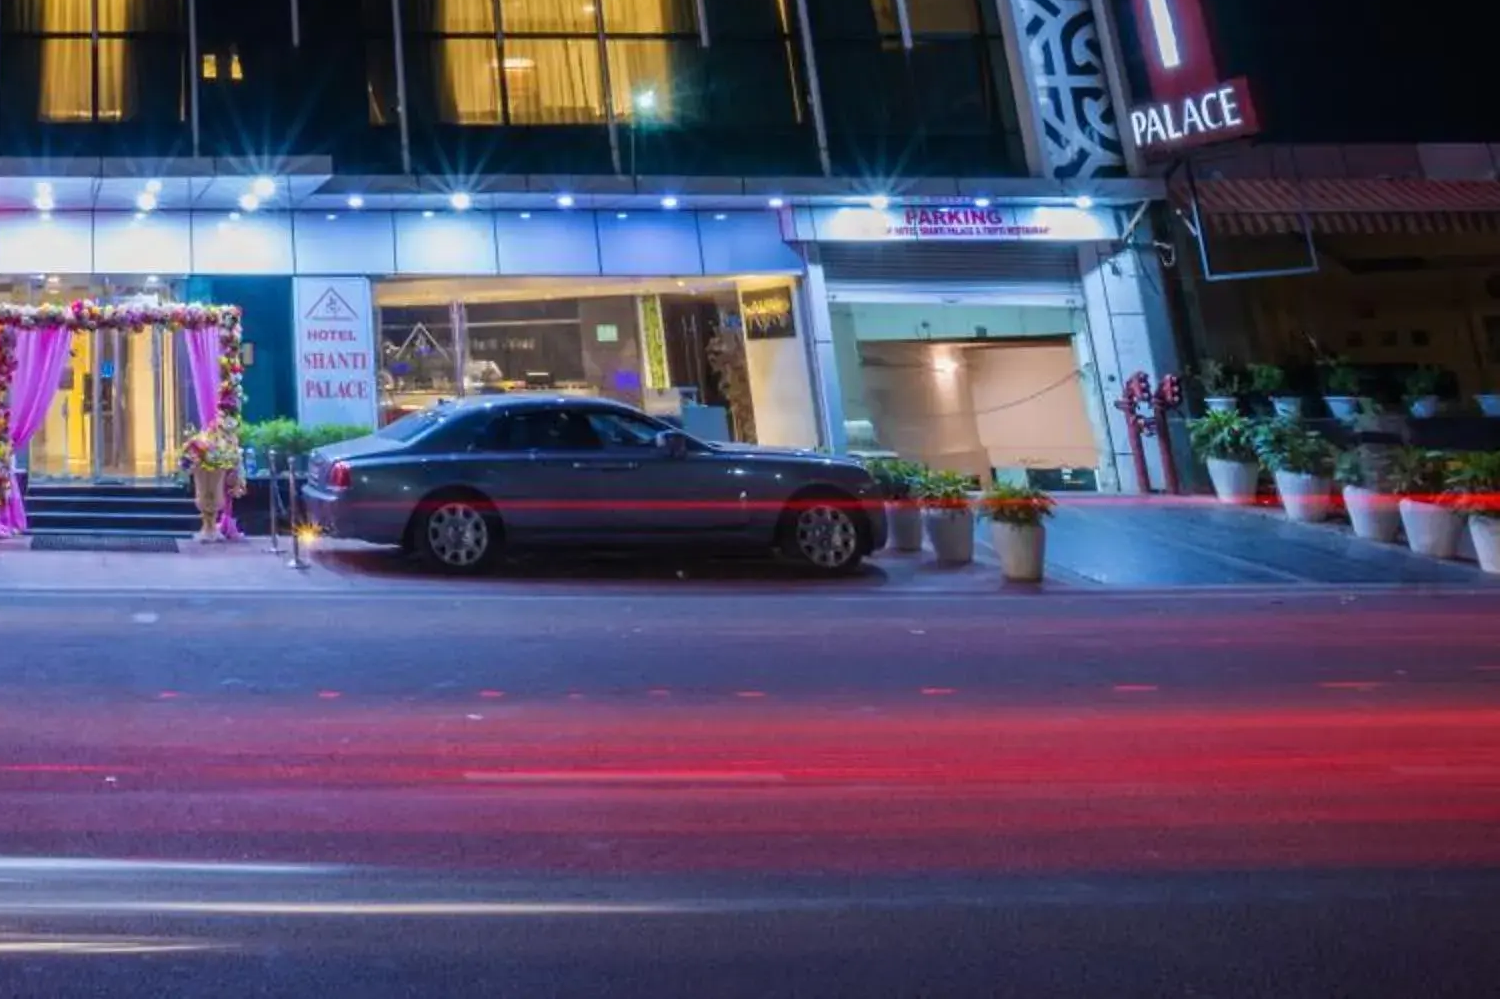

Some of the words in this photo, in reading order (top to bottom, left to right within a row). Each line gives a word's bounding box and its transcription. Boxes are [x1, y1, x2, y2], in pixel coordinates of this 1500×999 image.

[1130, 87, 1241, 149] PALACE
[905, 208, 1003, 226] PARKING
[307, 329, 356, 342] HOTEL
[303, 352, 368, 370] SHANTI
[305, 380, 368, 399] PALACE
